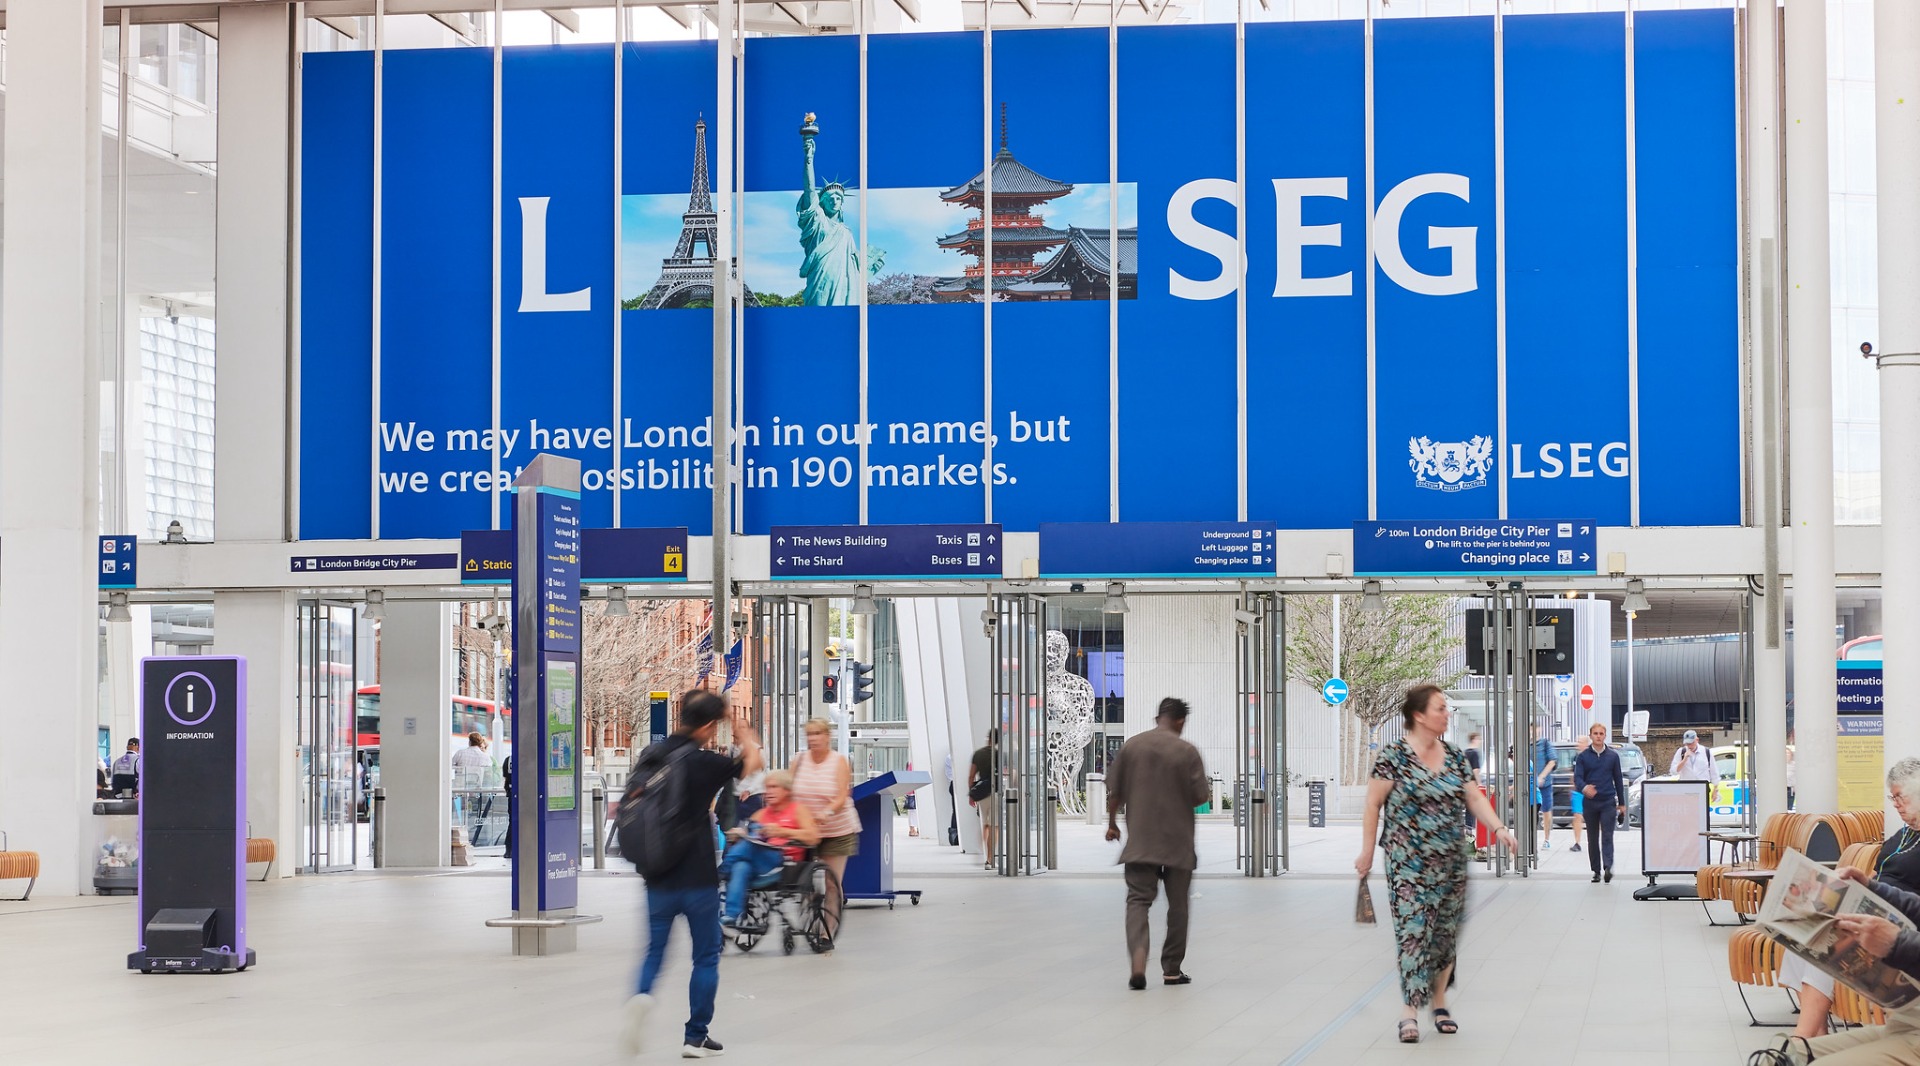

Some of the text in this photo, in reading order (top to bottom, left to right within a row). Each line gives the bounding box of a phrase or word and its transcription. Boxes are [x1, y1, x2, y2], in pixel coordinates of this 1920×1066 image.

[517, 196, 592, 313] L
[380, 421, 435, 452] We
[446, 427, 520, 459] may
[529, 418, 612, 450] have
[772, 416, 805, 446] in
[816, 422, 878, 446] our
[888, 419, 999, 449] name,
[1009, 411, 1070, 443] but
[1511, 441, 1630, 479] LSEG
[380, 470, 429, 494] we
[582, 457, 714, 492] ossibilit
[747, 458, 779, 489] in
[791, 456, 853, 488] 190
[866, 454, 1018, 486] markets.
[1202, 530, 1250, 540] Underground
[1388, 525, 1550, 539] 100m London Bridge City Pier
[792, 535, 888, 548] The News Building
[936, 535, 963, 545] Taxis
[1436, 540, 1450, 548] The
[1451, 540, 1462, 548] lift
[1472, 540, 1485, 548] the
[1486, 541, 1501, 549] pier
[1509, 540, 1535, 548] behind
[1201, 543, 1249, 553] Left Luggage
[320, 557, 417, 571] London Bridge City Pier
[669, 557, 678, 568] 4
[792, 556, 843, 566] The Shard
[931, 554, 962, 565] Buses
[1194, 556, 1249, 566] Changing place
[1461, 551, 1550, 566] Changing place
[482, 559, 512, 570] Statio
[1837, 676, 1882, 686] nformatio
[1847, 720, 1883, 728] WARNING
[166, 732, 214, 740] INFORMATION
